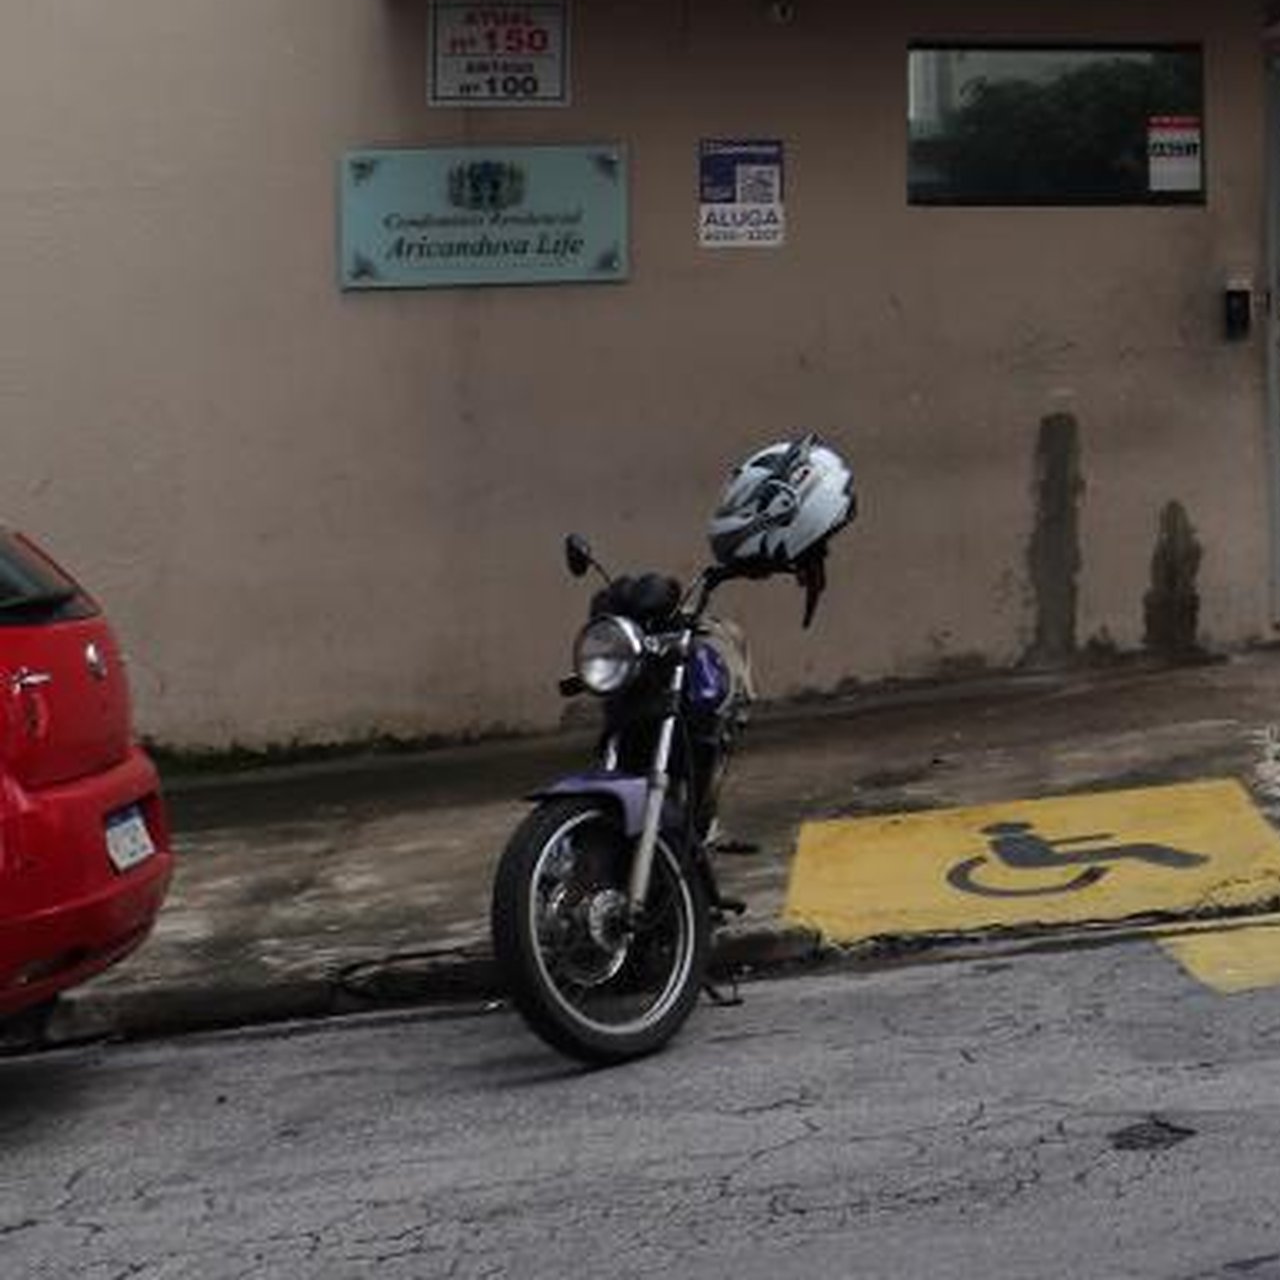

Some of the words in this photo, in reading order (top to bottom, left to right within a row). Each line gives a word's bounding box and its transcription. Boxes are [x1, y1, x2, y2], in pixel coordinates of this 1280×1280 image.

[485, 28, 548, 53] 150
[485, 75, 539, 96] 100
[704, 208, 778, 228] ALUGA
[535, 233, 585, 261] Life
